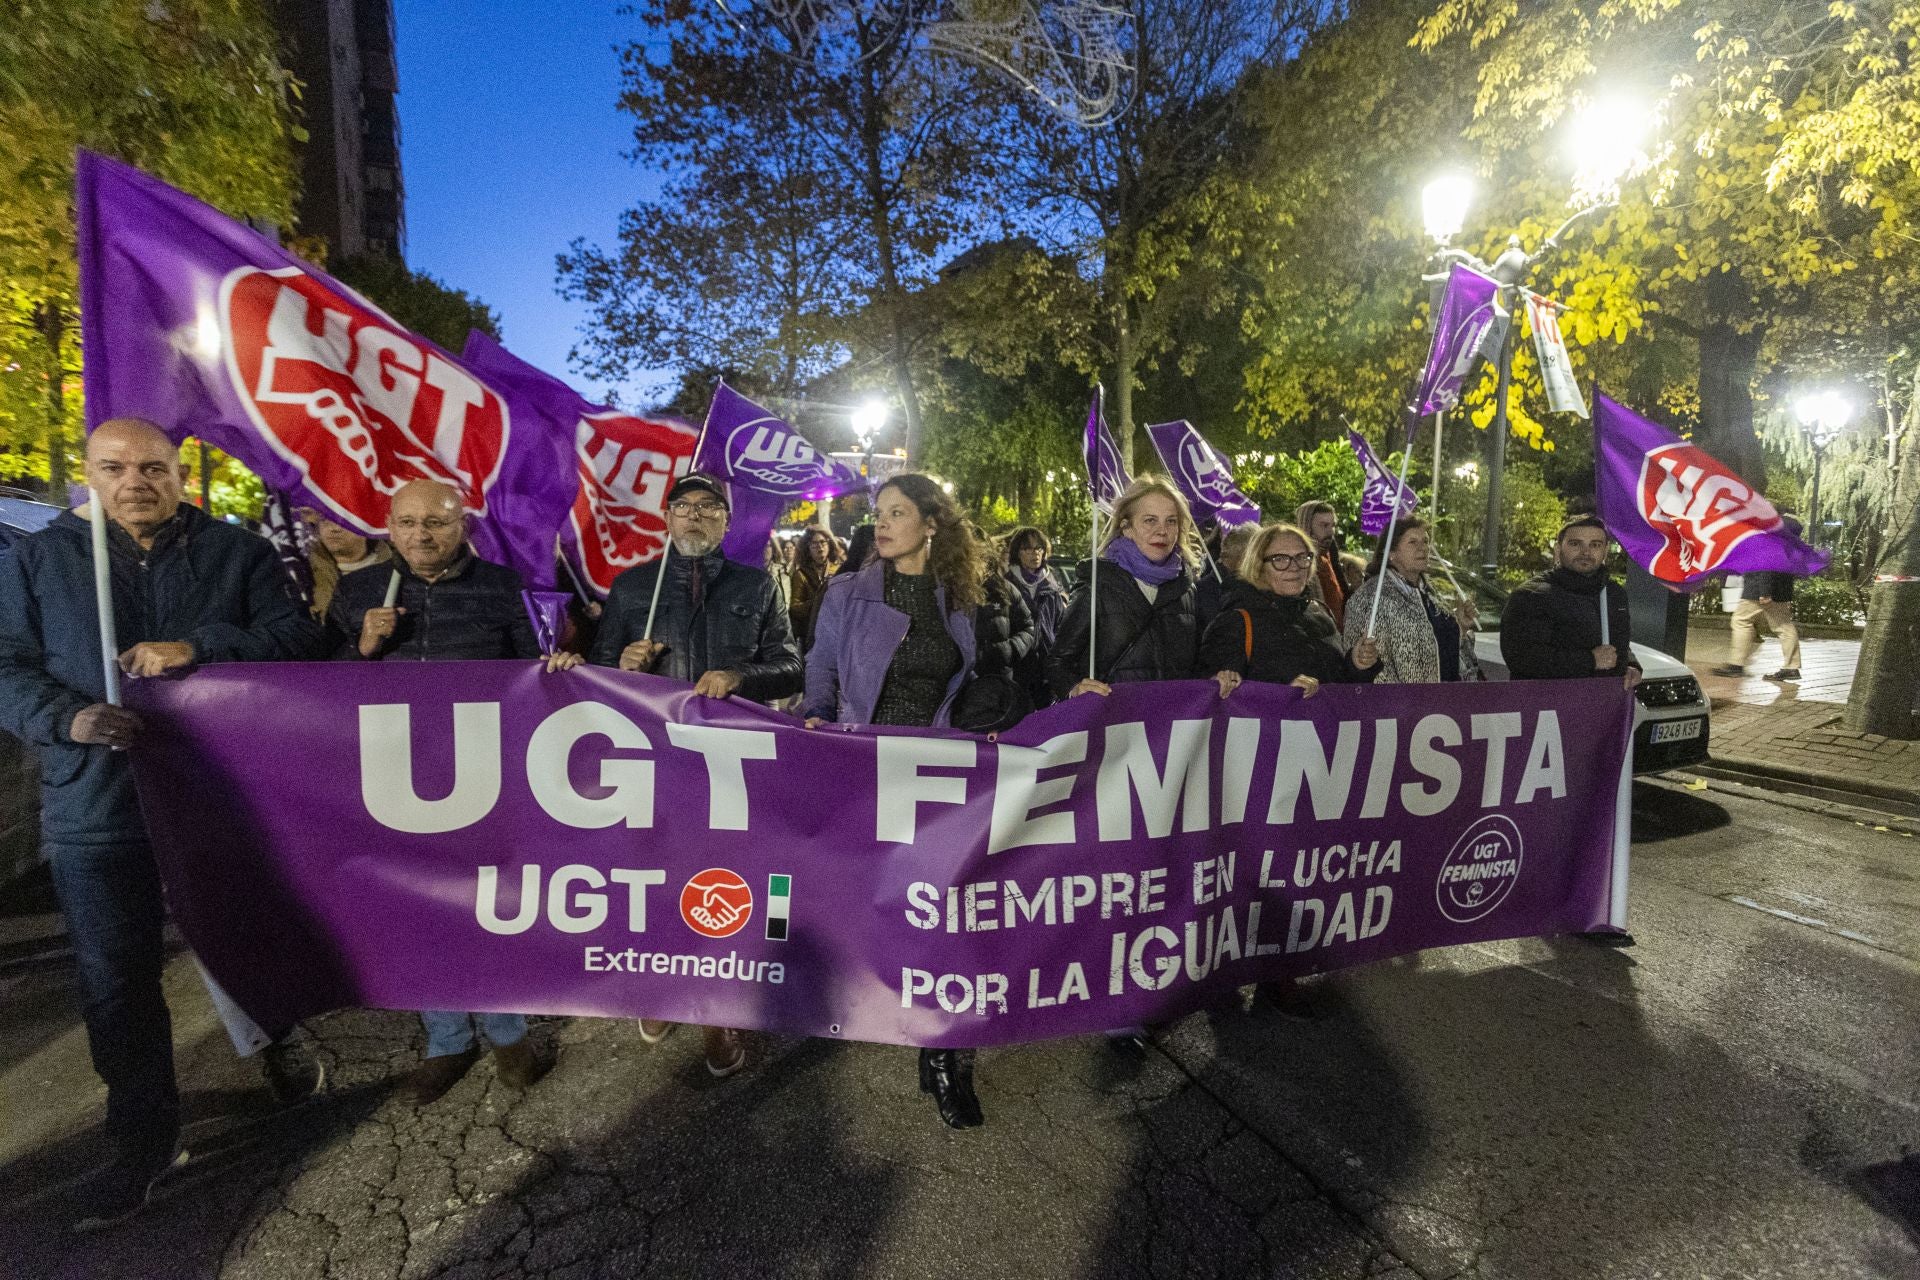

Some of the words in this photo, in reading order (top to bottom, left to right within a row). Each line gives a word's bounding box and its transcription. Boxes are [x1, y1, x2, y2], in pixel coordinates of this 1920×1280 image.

[267, 285, 484, 469] UGT
[1658, 724, 1681, 739] 9248
[358, 701, 777, 833] UGT
[876, 710, 1566, 854] FEMINISTA
[905, 867, 1168, 933] SIEMPRE
[1193, 851, 1236, 905] EN
[1259, 839, 1401, 889] LUCHA
[1441, 859, 1516, 883] FEMINISTA
[1473, 842, 1501, 860] UGT
[475, 864, 666, 935] UGT
[584, 946, 785, 984] Extremadura
[901, 967, 1009, 1016] POR
[1027, 962, 1091, 1009] LA
[1108, 885, 1393, 996] IGUALDAD
